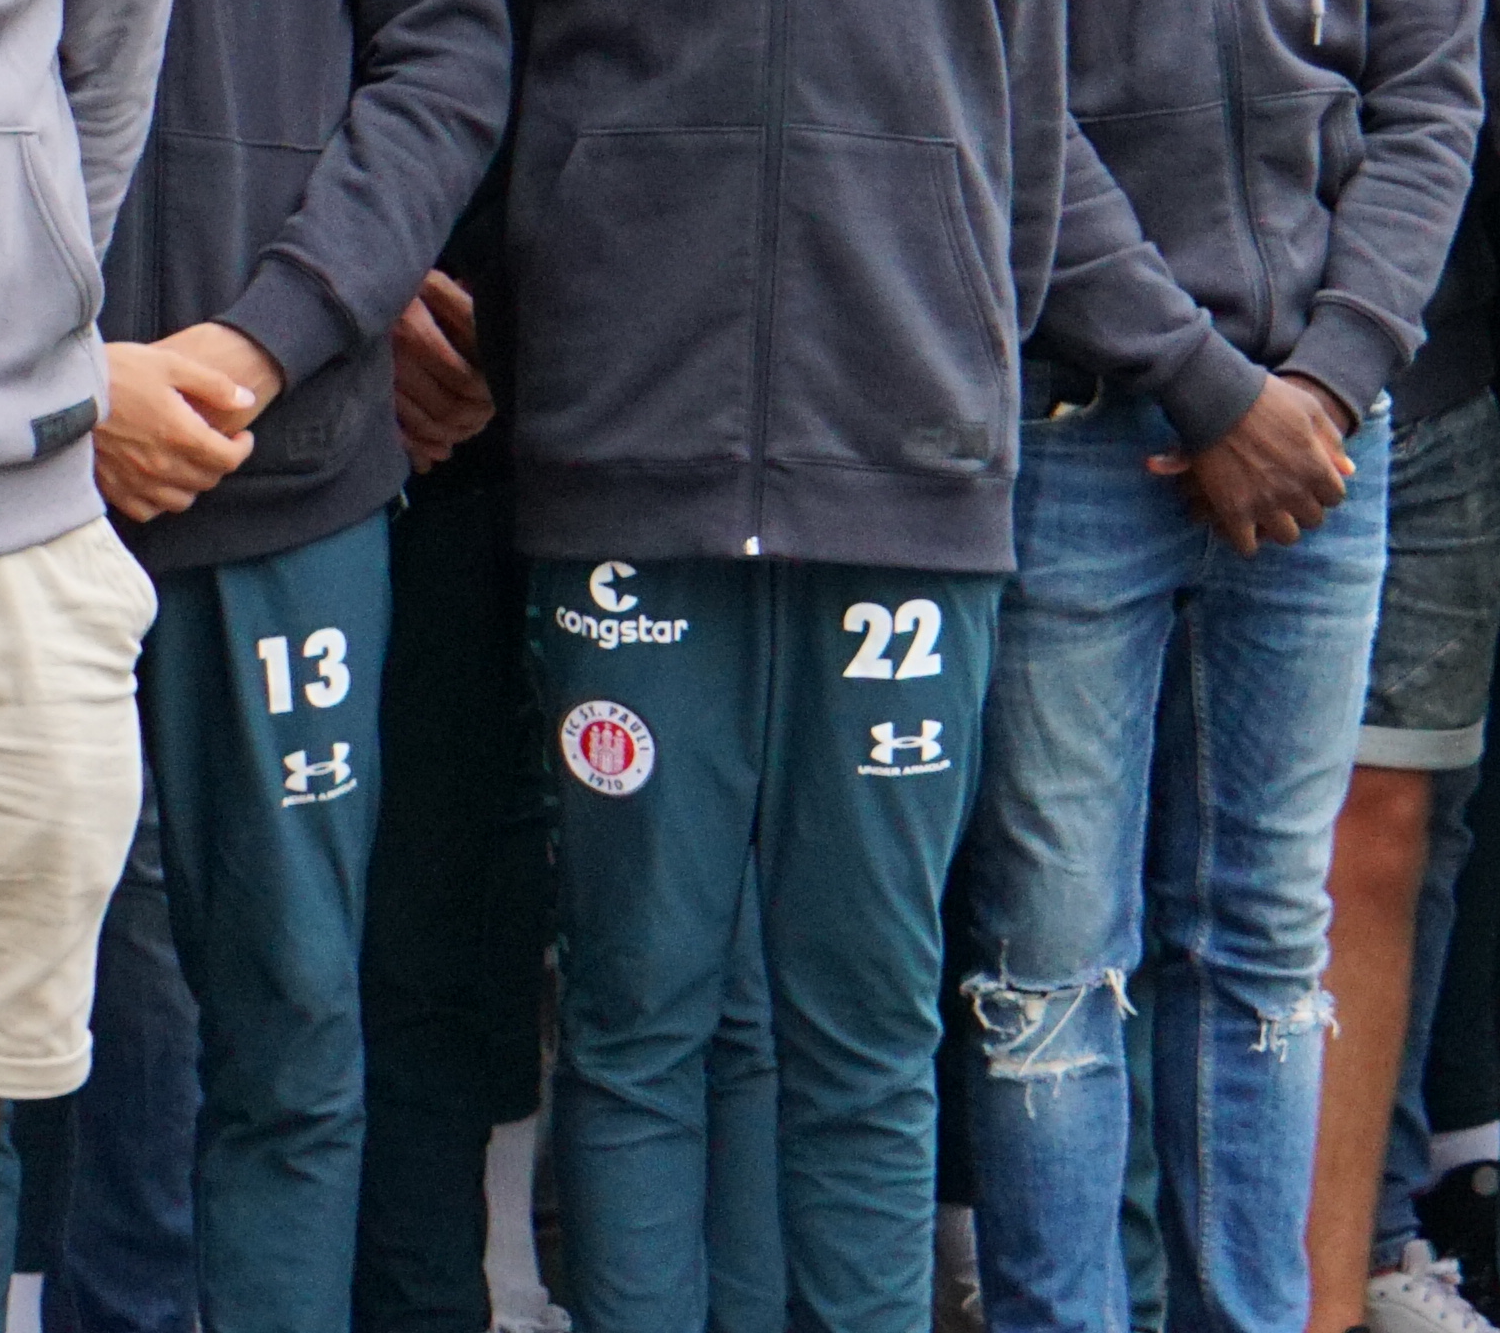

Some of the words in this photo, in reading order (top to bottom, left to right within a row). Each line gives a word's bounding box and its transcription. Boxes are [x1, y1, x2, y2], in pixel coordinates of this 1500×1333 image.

[555, 606, 689, 649] congstar
[842, 598, 943, 680] 22
[257, 626, 351, 714] 13
[565, 720, 579, 738] FC
[607, 704, 651, 754] PAULI
[588, 774, 624, 792] 1910
